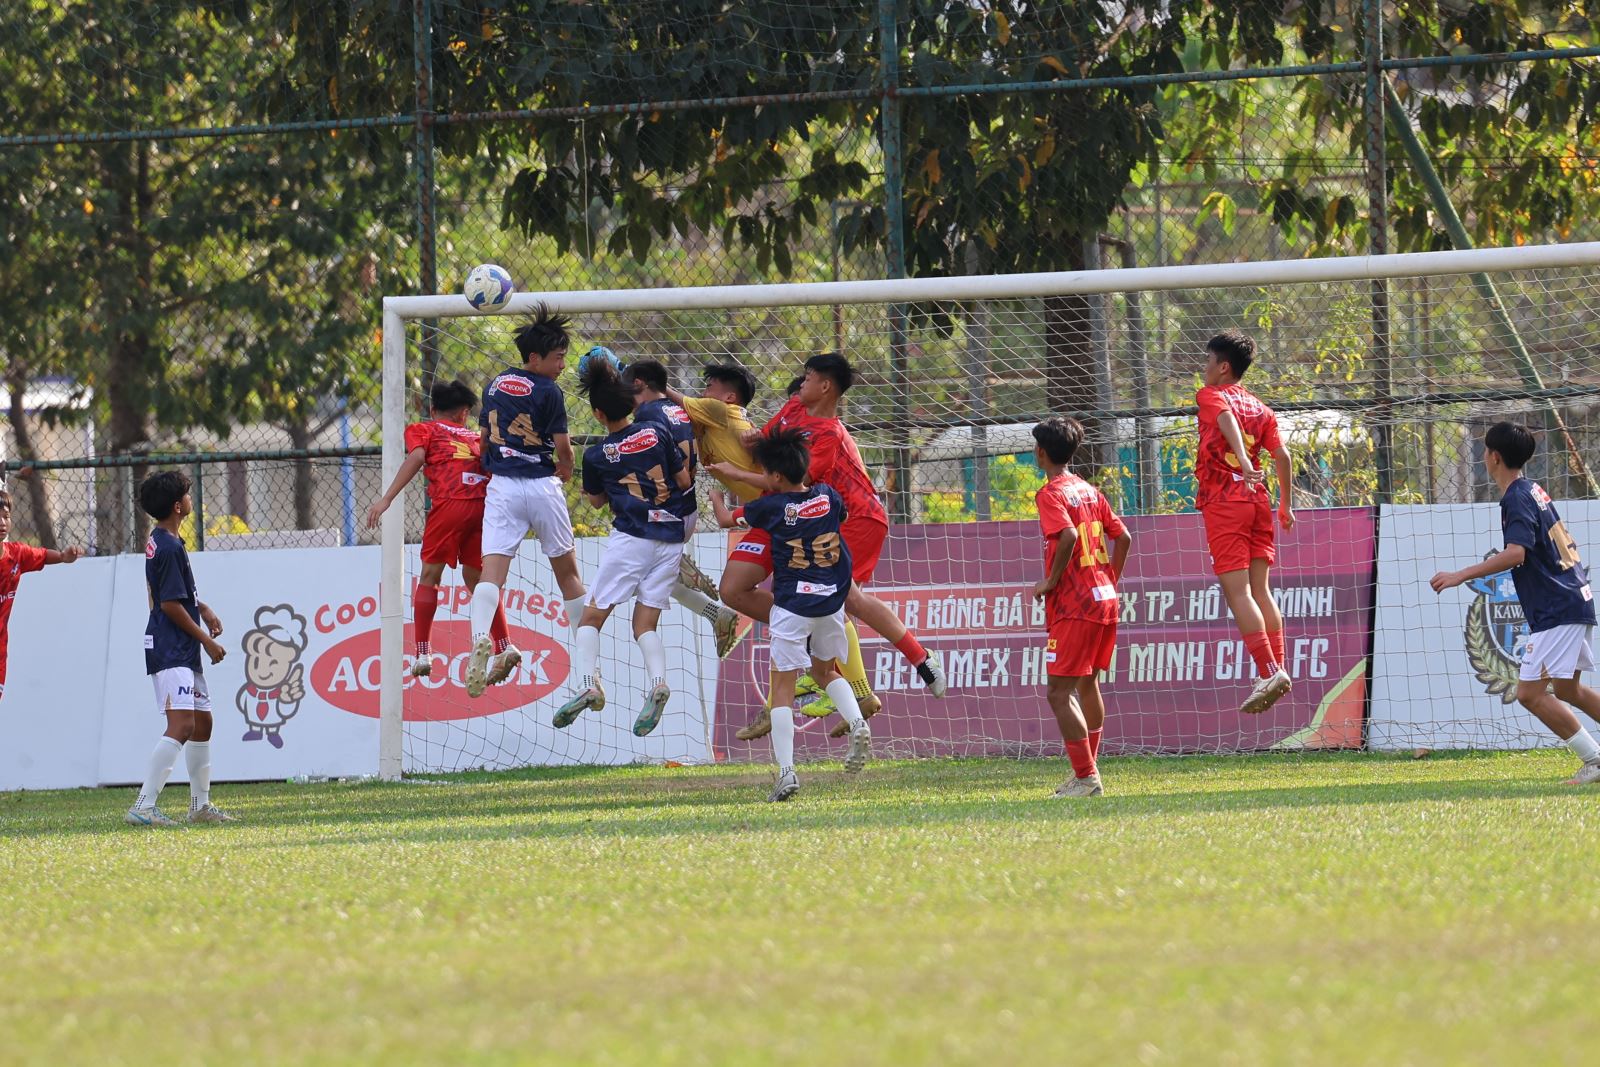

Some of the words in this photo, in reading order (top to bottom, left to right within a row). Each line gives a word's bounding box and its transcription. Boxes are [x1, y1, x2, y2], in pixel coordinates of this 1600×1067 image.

[489, 409, 543, 446] 14
[618, 463, 671, 505] 11
[784, 531, 841, 570] 18
[314, 581, 382, 634] Coo
[926, 594, 986, 629] BÓNG
[993, 592, 1023, 627] ĐÁ
[1145, 591, 1180, 622] TP.
[1272, 586, 1333, 618] MINH
[1128, 641, 1206, 683] MINH
[1292, 638, 1329, 679] FC
